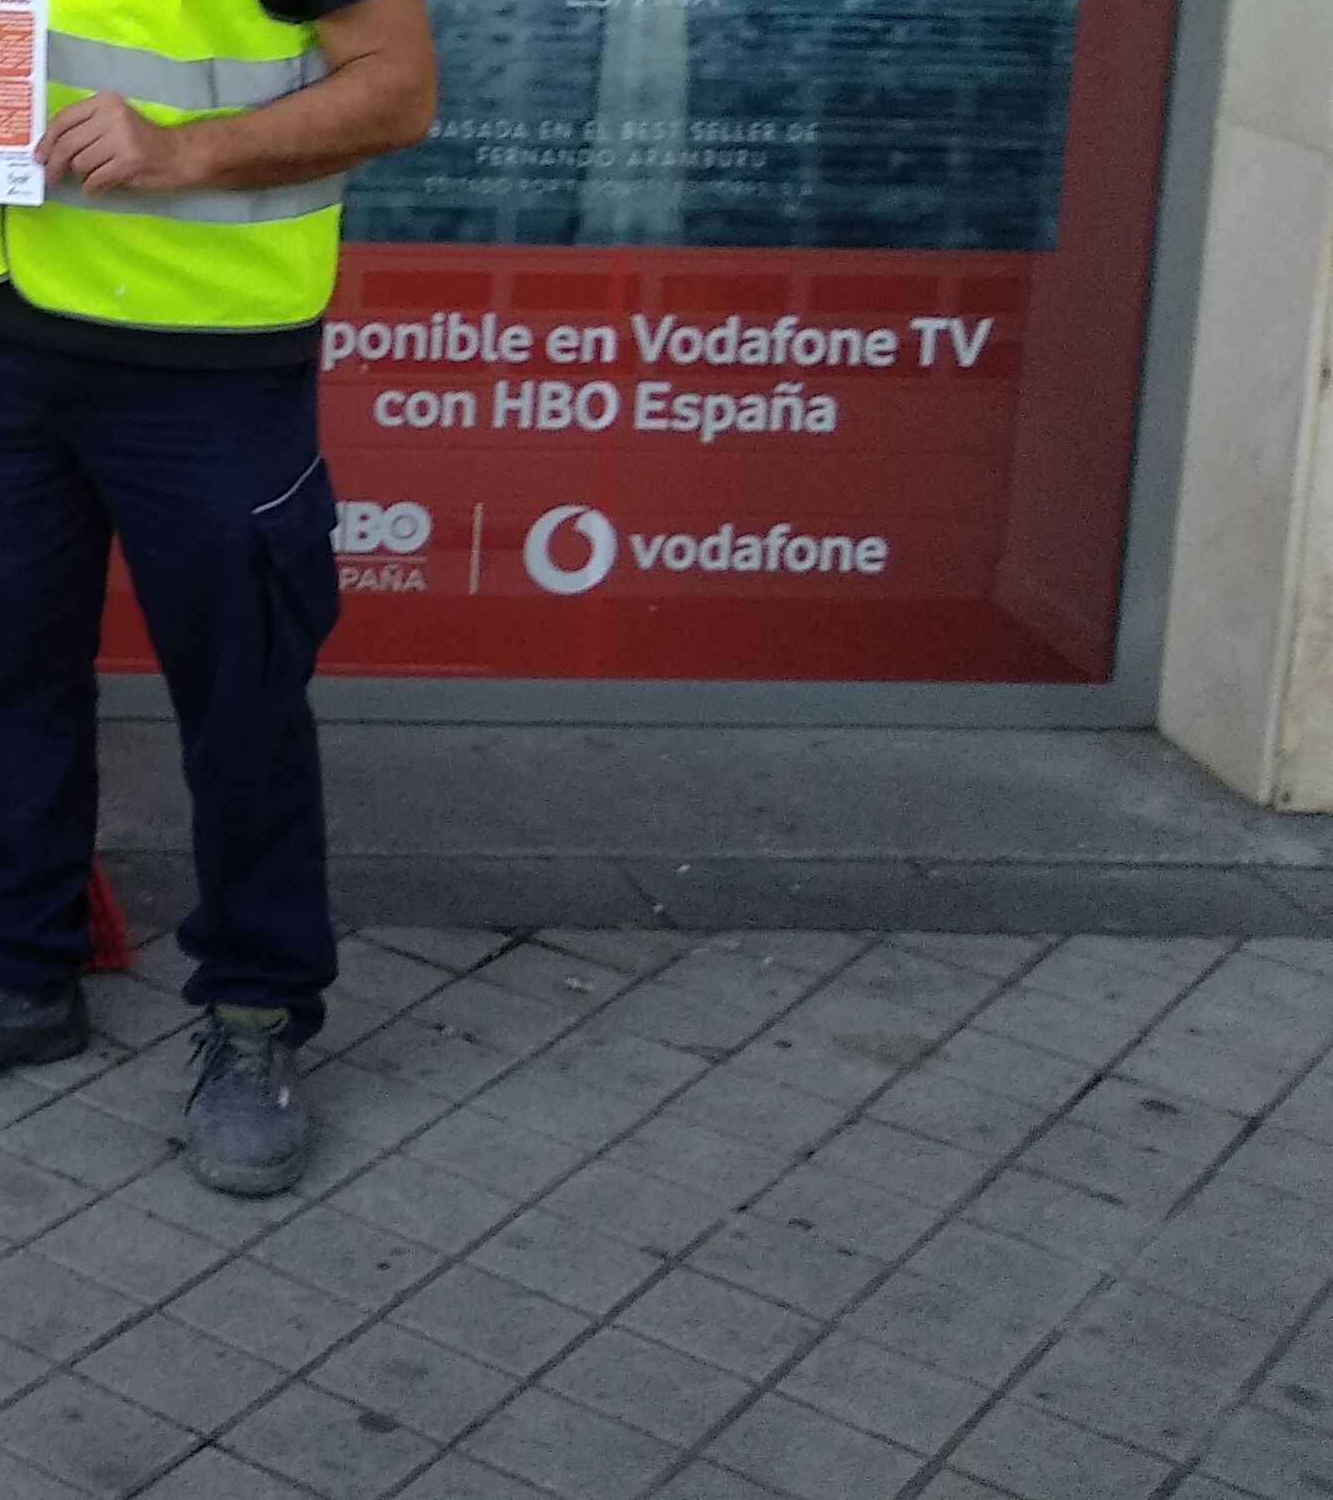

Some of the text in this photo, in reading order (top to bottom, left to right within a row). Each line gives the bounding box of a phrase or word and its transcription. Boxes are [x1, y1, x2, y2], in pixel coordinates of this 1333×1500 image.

[539, 120, 573, 139] EN
[620, 121, 679, 141] BEST
[689, 121, 776, 142] SELLER
[785, 122, 821, 143] DE
[476, 146, 768, 168] FERNANDO ARAMBURU
[321, 312, 992, 372] ponible en Vodafone TV
[373, 381, 838, 441] con HBO España
[629, 522, 889, 573] vodafone
[337, 563, 429, 592] PAÑA
